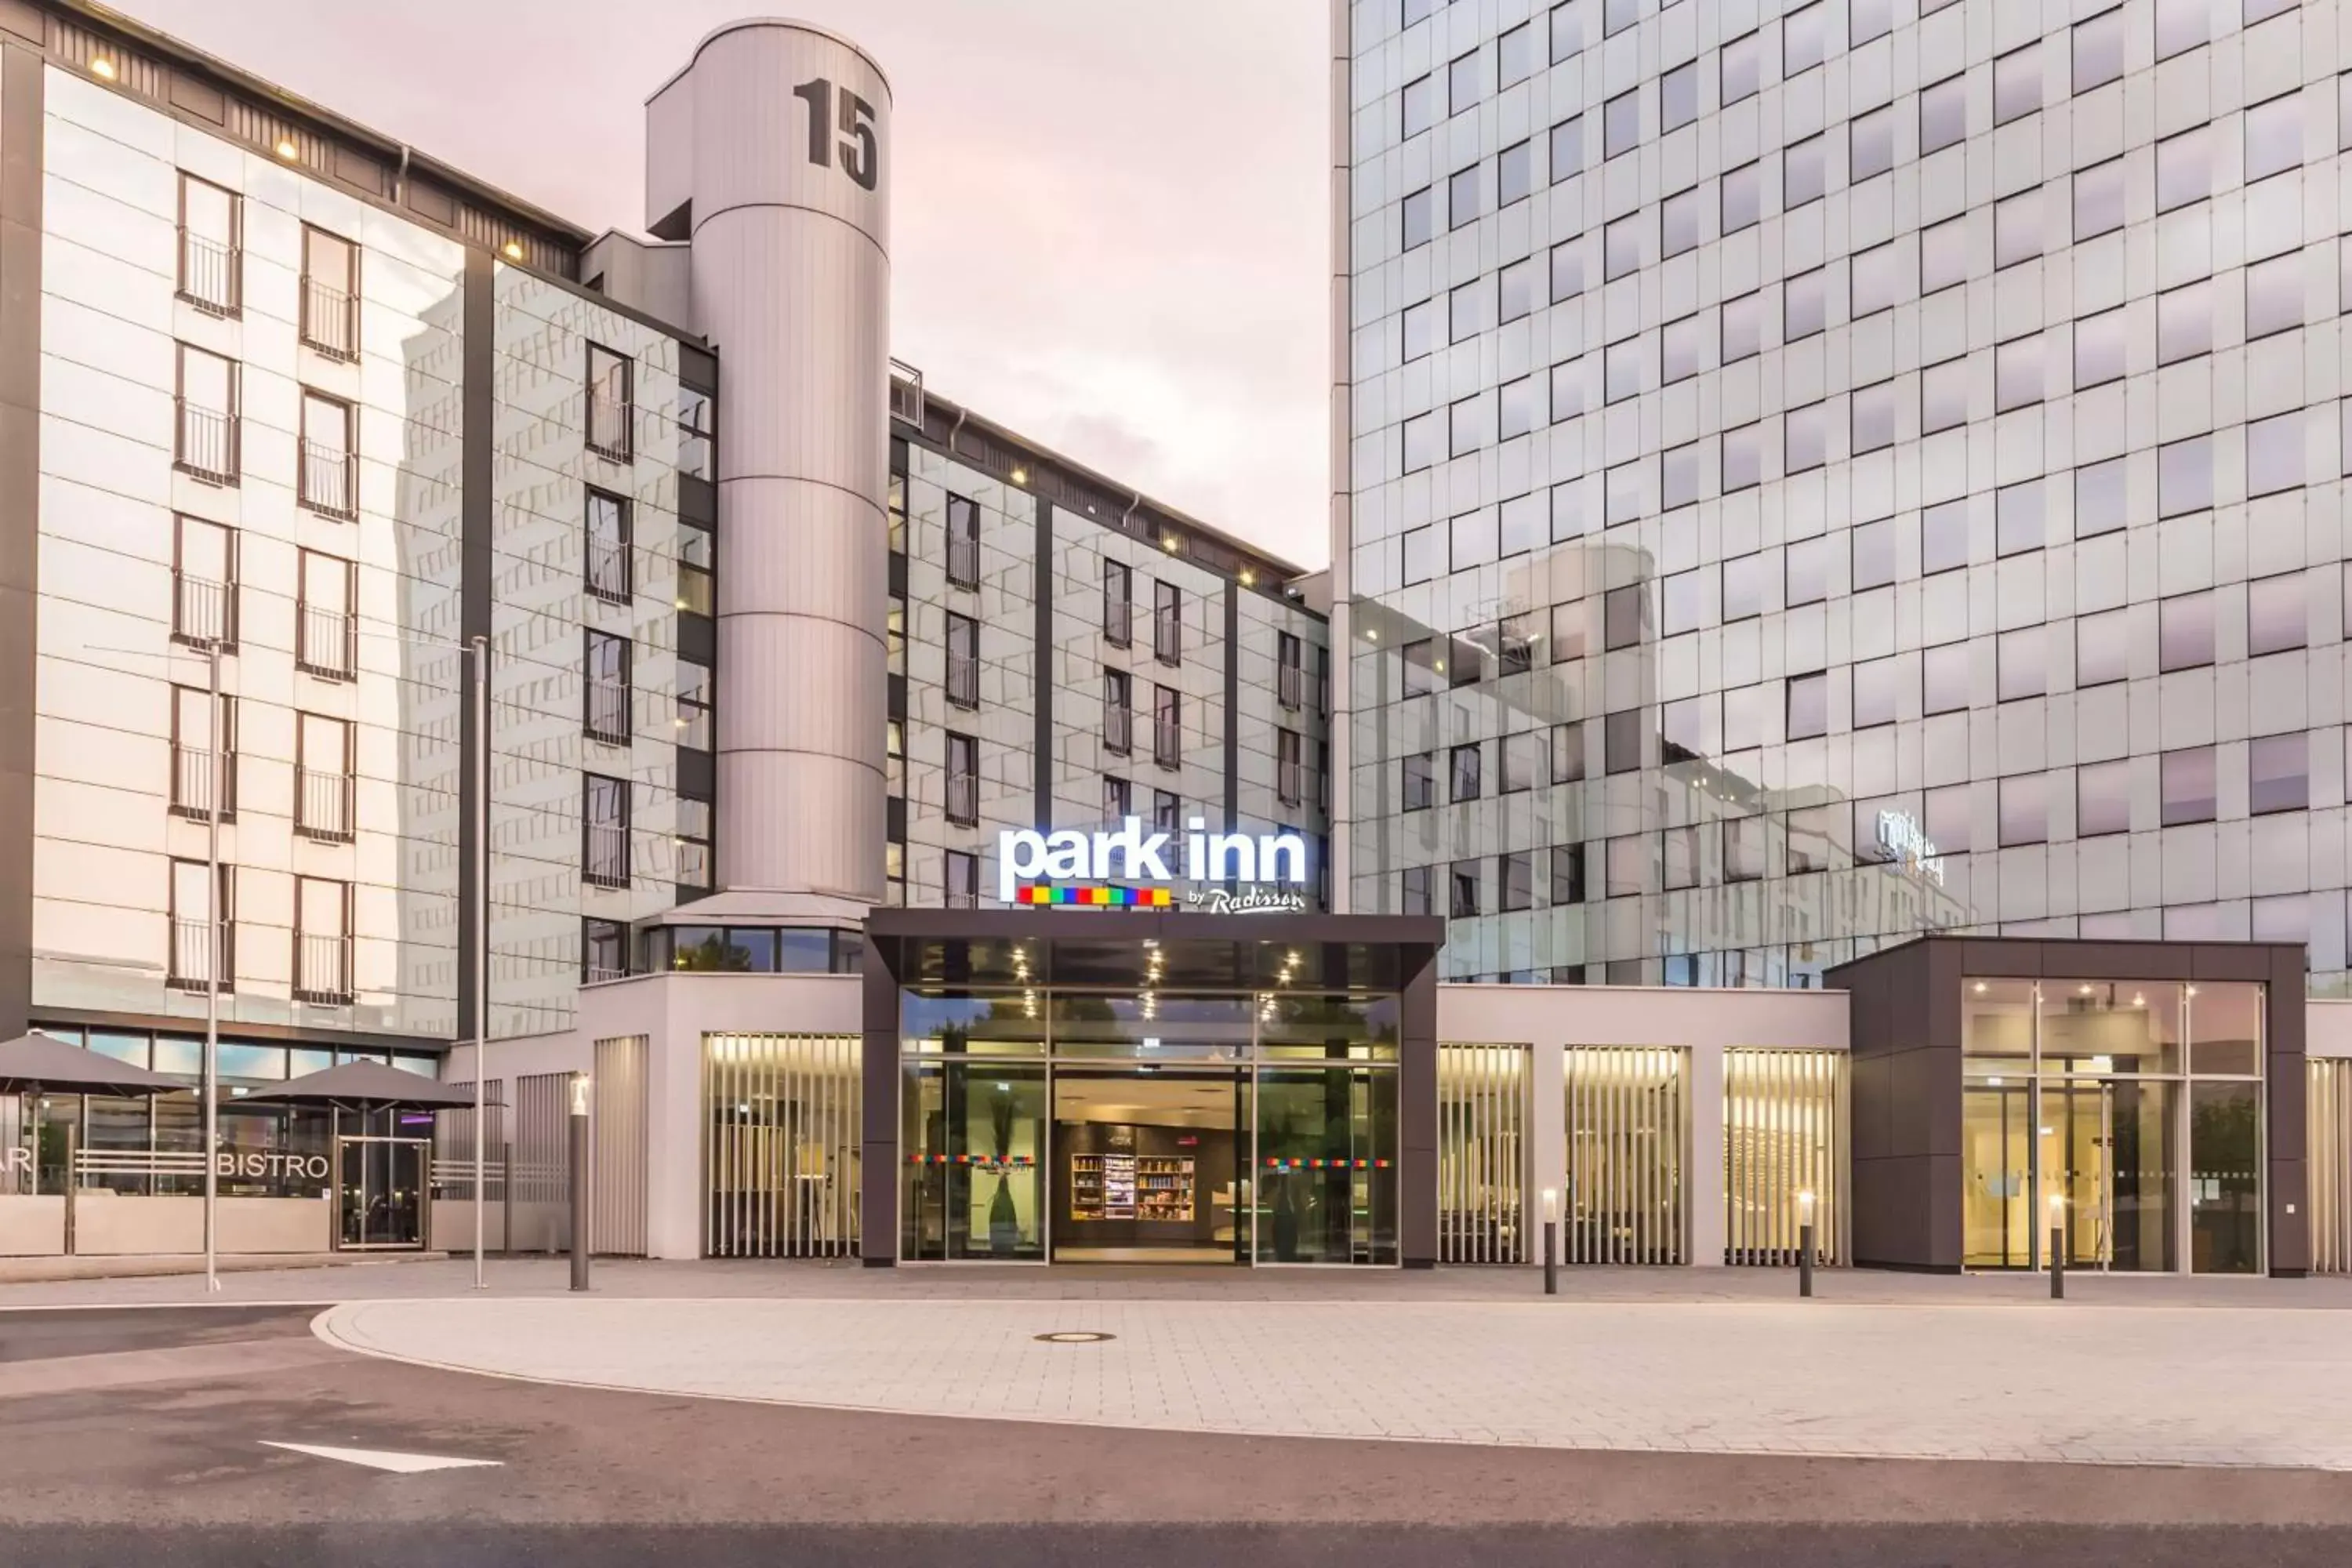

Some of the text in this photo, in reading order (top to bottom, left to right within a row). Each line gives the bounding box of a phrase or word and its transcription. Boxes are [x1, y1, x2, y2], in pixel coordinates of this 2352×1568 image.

[793, 78, 877, 191] 15
[999, 815, 1305, 902] park inn
[1189, 884, 1305, 914] by Radisson
[216, 1153, 329, 1178] BISTRO
